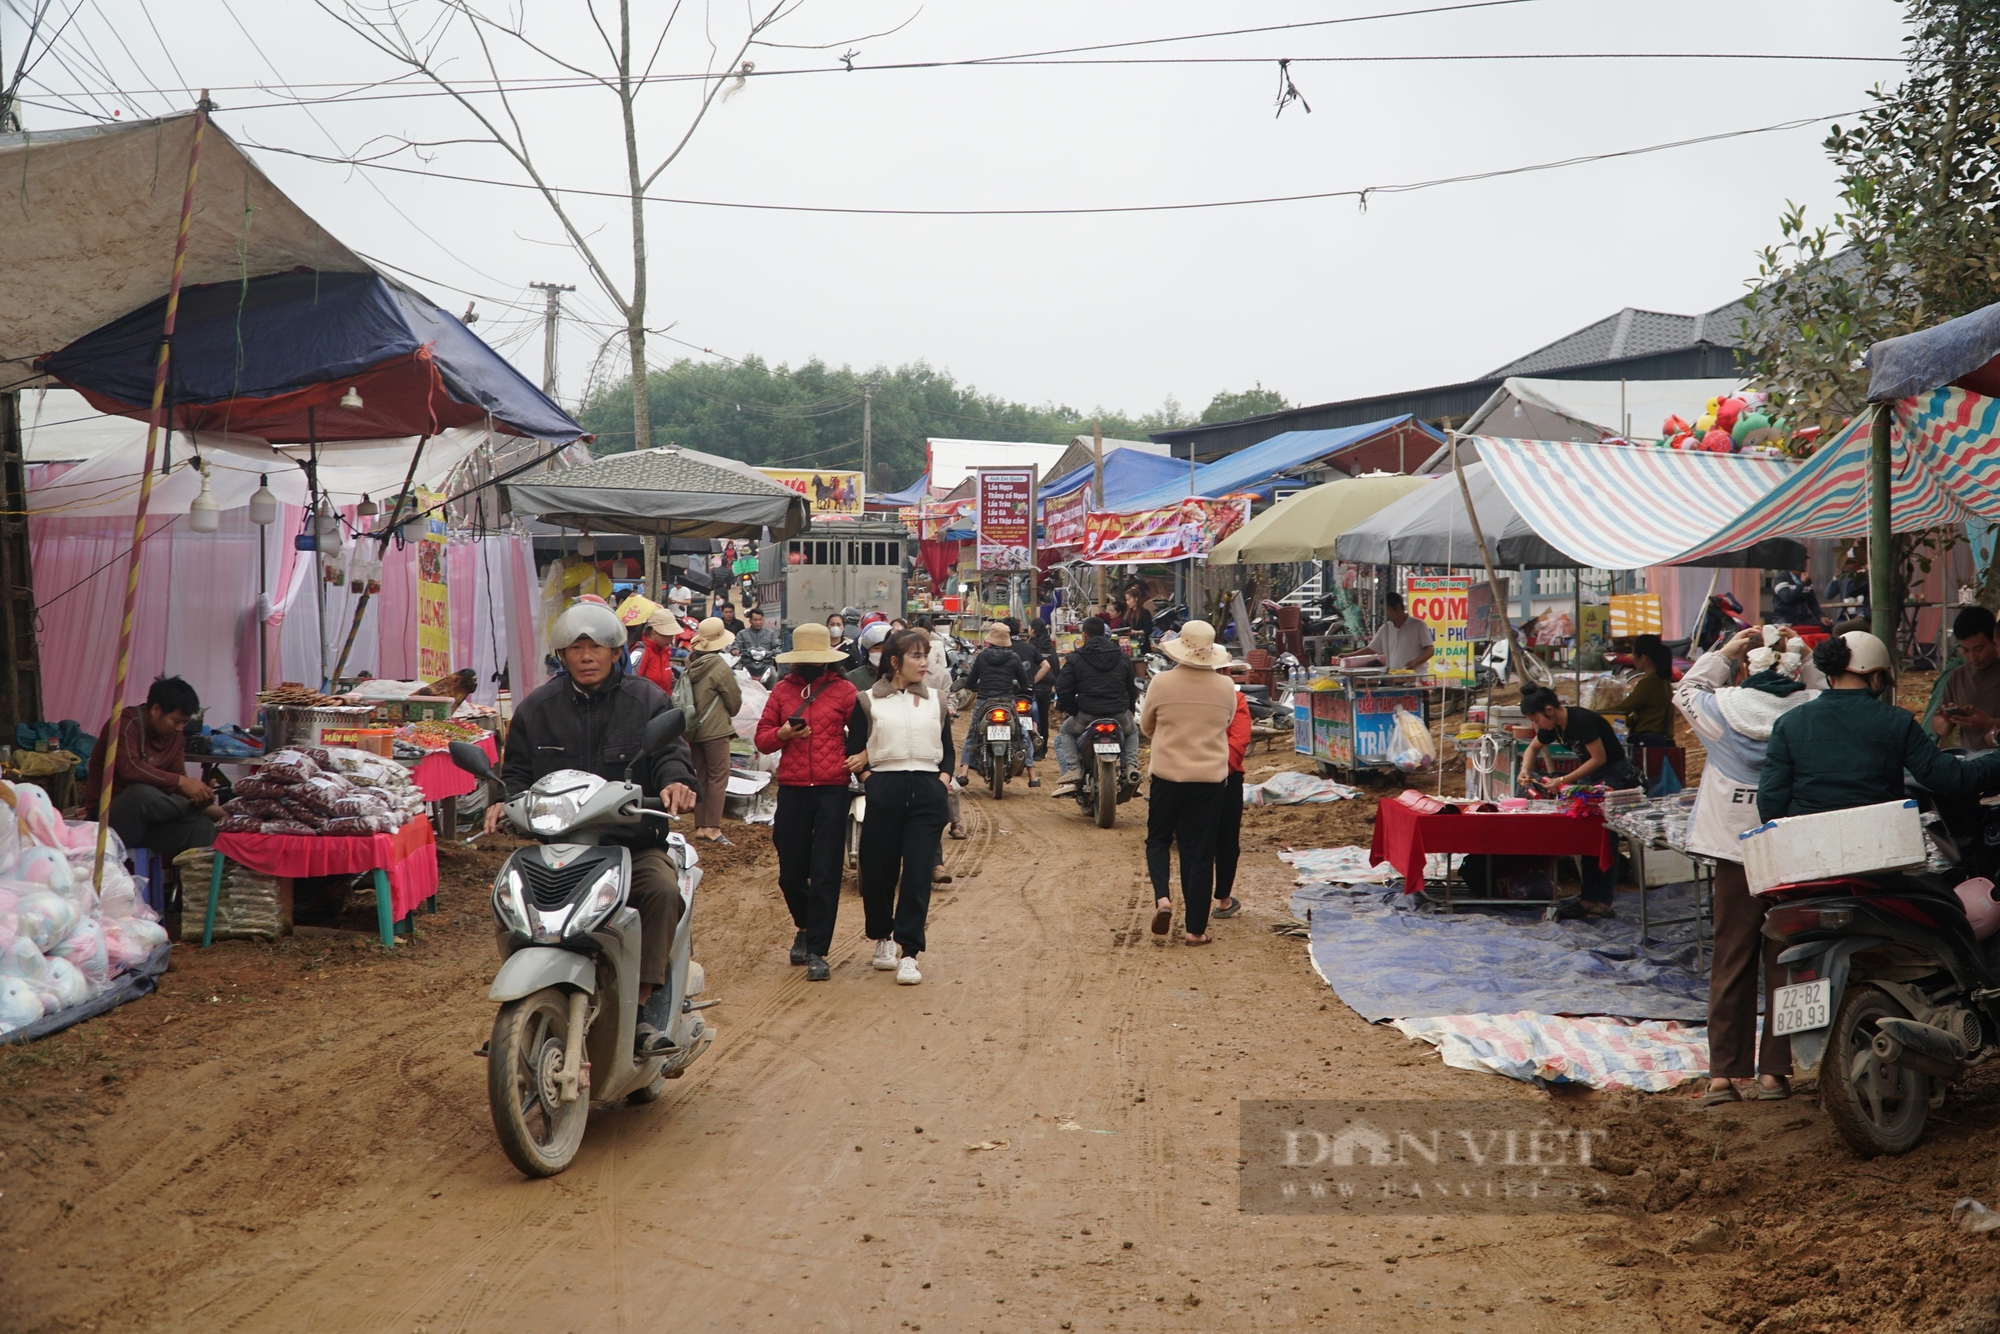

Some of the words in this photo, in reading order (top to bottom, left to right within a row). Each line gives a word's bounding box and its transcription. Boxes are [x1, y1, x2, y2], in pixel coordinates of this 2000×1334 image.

[324, 732, 342, 742] MÁY
[1782, 984, 1822, 1010] 22-B2
[1777, 1005, 1826, 1032] 828.93
